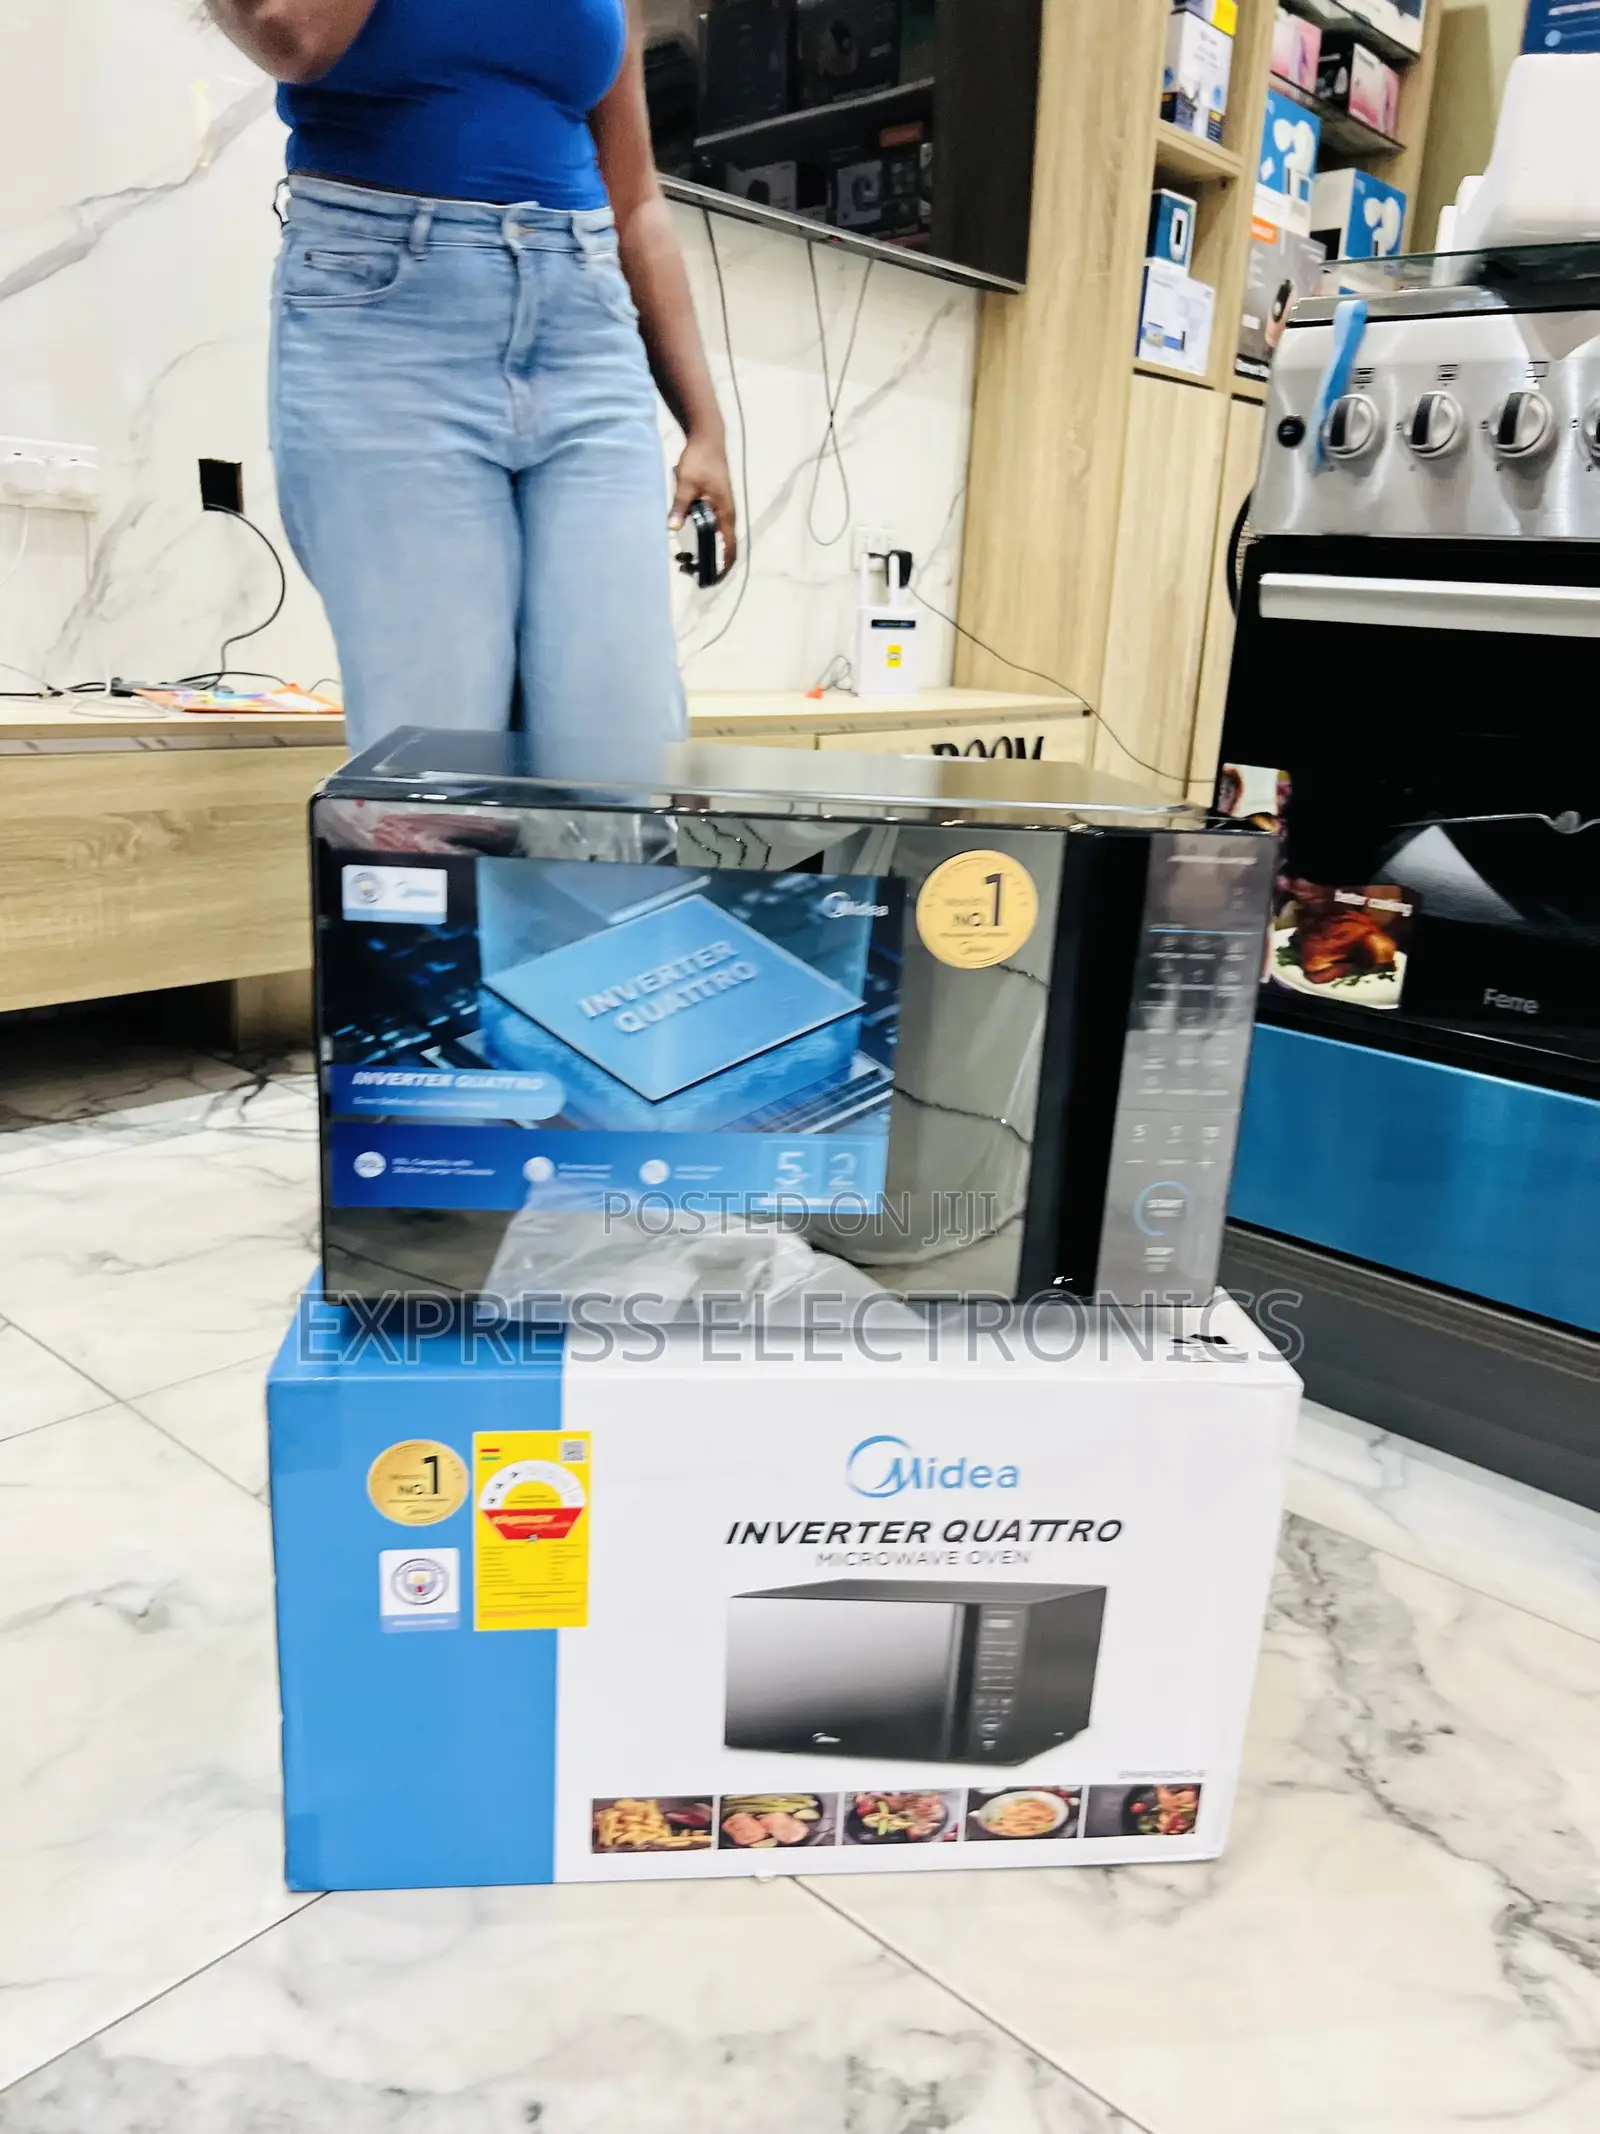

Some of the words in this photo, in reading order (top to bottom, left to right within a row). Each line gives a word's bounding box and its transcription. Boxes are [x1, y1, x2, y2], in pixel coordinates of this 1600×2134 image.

[578, 940, 740, 1019] INVERTER
[615, 961, 758, 1033] QUATTRO
[352, 1071, 454, 1088] INVERTER
[423, 1455, 440, 1495] 1
[844, 1434, 1021, 1499] Midea
[725, 1519, 931, 1545] INVERTER
[941, 1518, 1123, 1544] QUATTRO
[815, 1550, 958, 1568] MICROWAVE
[965, 1549, 1031, 1565] OVEN
